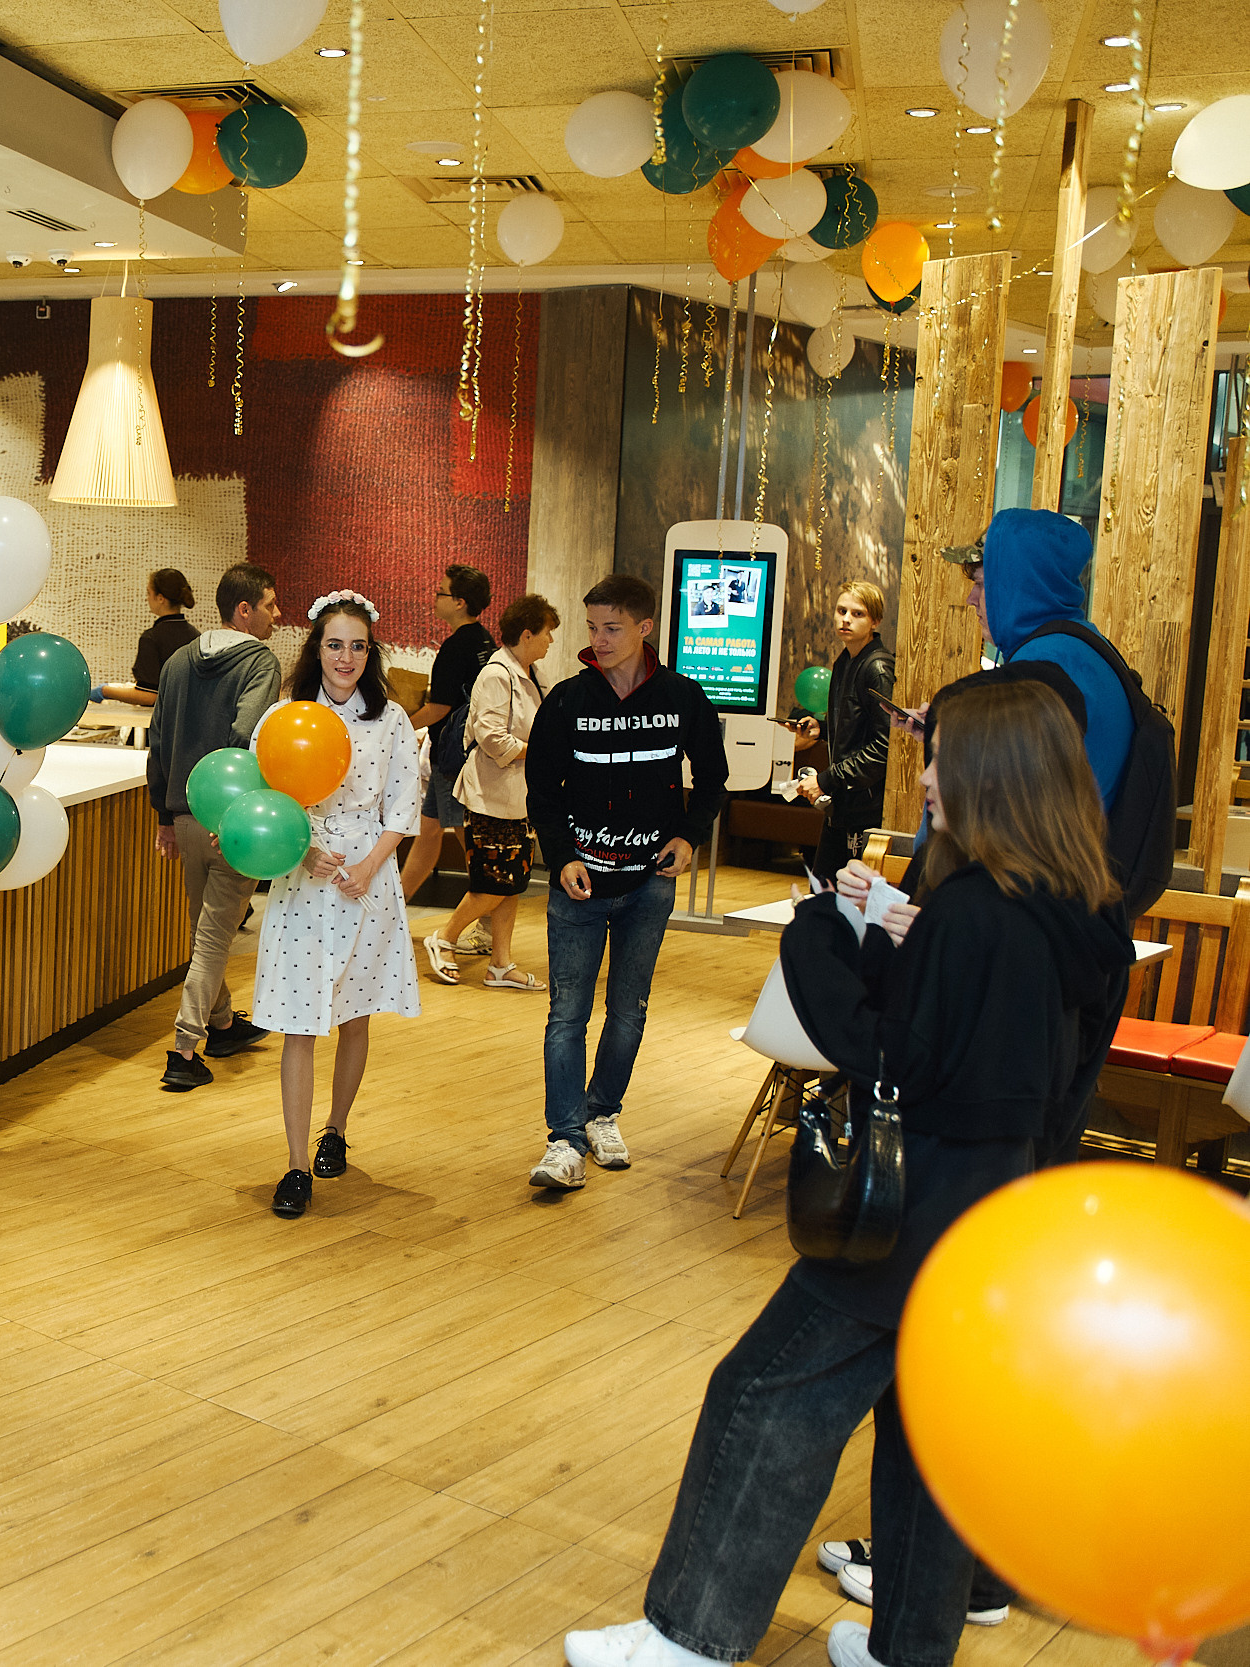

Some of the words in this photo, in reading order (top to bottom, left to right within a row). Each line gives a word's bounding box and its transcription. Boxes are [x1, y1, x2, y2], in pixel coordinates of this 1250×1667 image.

[684, 636, 694, 646] ТА
[695, 636, 724, 647] САМАЯ
[725, 637, 756, 648] РАБОТА
[682, 645, 693, 654] НА
[693, 646, 711, 655] ЛЕТО
[711, 647, 717, 656] И
[718, 647, 728, 656] НЕ
[728, 648, 756, 658] ТОЛЬКО
[576, 714, 680, 731] EDENGLON
[595, 827, 624, 847] for
